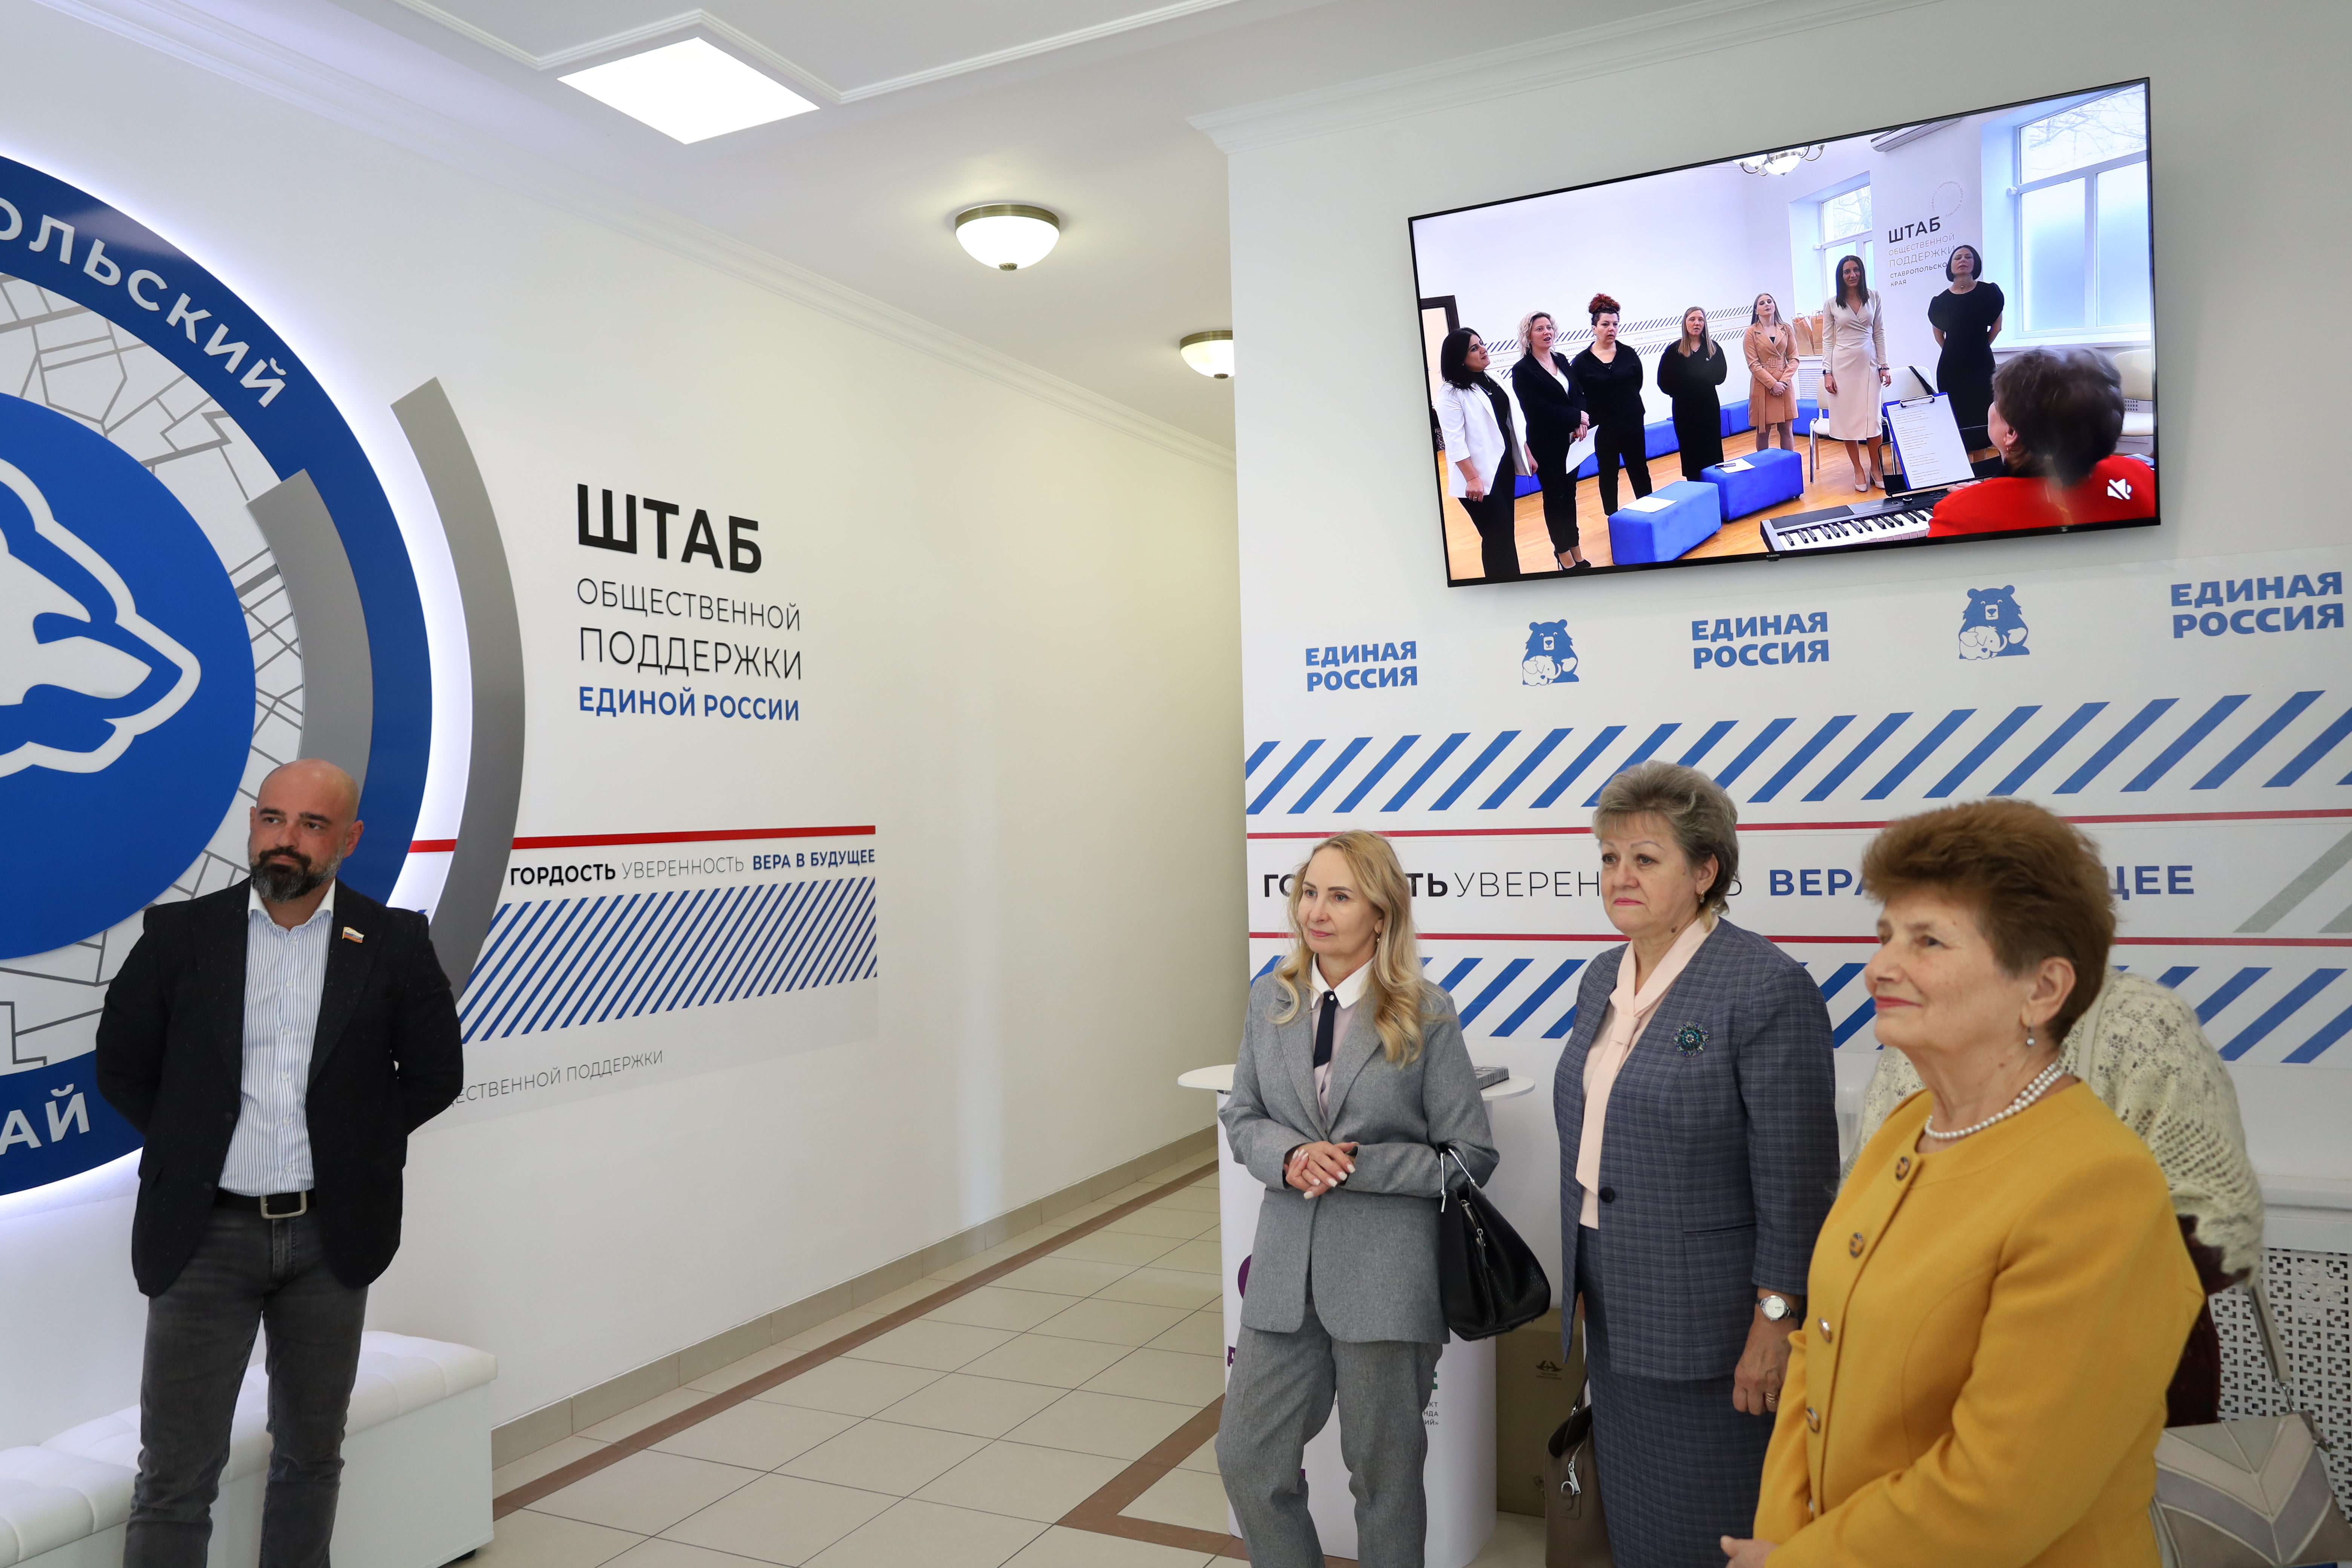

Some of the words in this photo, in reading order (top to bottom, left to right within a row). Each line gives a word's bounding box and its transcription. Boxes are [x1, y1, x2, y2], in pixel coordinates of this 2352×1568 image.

[1888, 216, 1940, 243] ШТАБ
[1888, 233, 1955, 256] ОБЩЕСТВЕННОЙ
[1889, 245, 1955, 268] ПОДДЕРЖКИ
[577, 483, 762, 573] ШТАБ
[577, 578, 800, 631] ОБЩЕСТВЕННОЙ
[2170, 571, 2343, 607] ЕДИНАЯ
[1692, 611, 1828, 642] ЕДИНАЯ
[2173, 603, 2344, 639] РОССИЯ
[580, 627, 801, 680] ПОДДЕРЖКИ
[1306, 641, 1417, 668] ЕДИНАЯ
[1694, 639, 1829, 669] РОССИЯ
[1306, 666, 1418, 692] РОССИЯ
[580, 686, 695, 717] ЕДИНОЙ
[704, 694, 799, 721] РОССИИ
[510, 863, 616, 886] ГОРДОСТЬ
[622, 856, 744, 879] УВЕРЕННОСТЬ
[753, 854, 790, 870] ВЕРА
[796, 853, 805, 868] В
[810, 849, 875, 867] БУДУЩЕЕ
[567, 1050, 663, 1082] ПОДДЕРЖКИ
